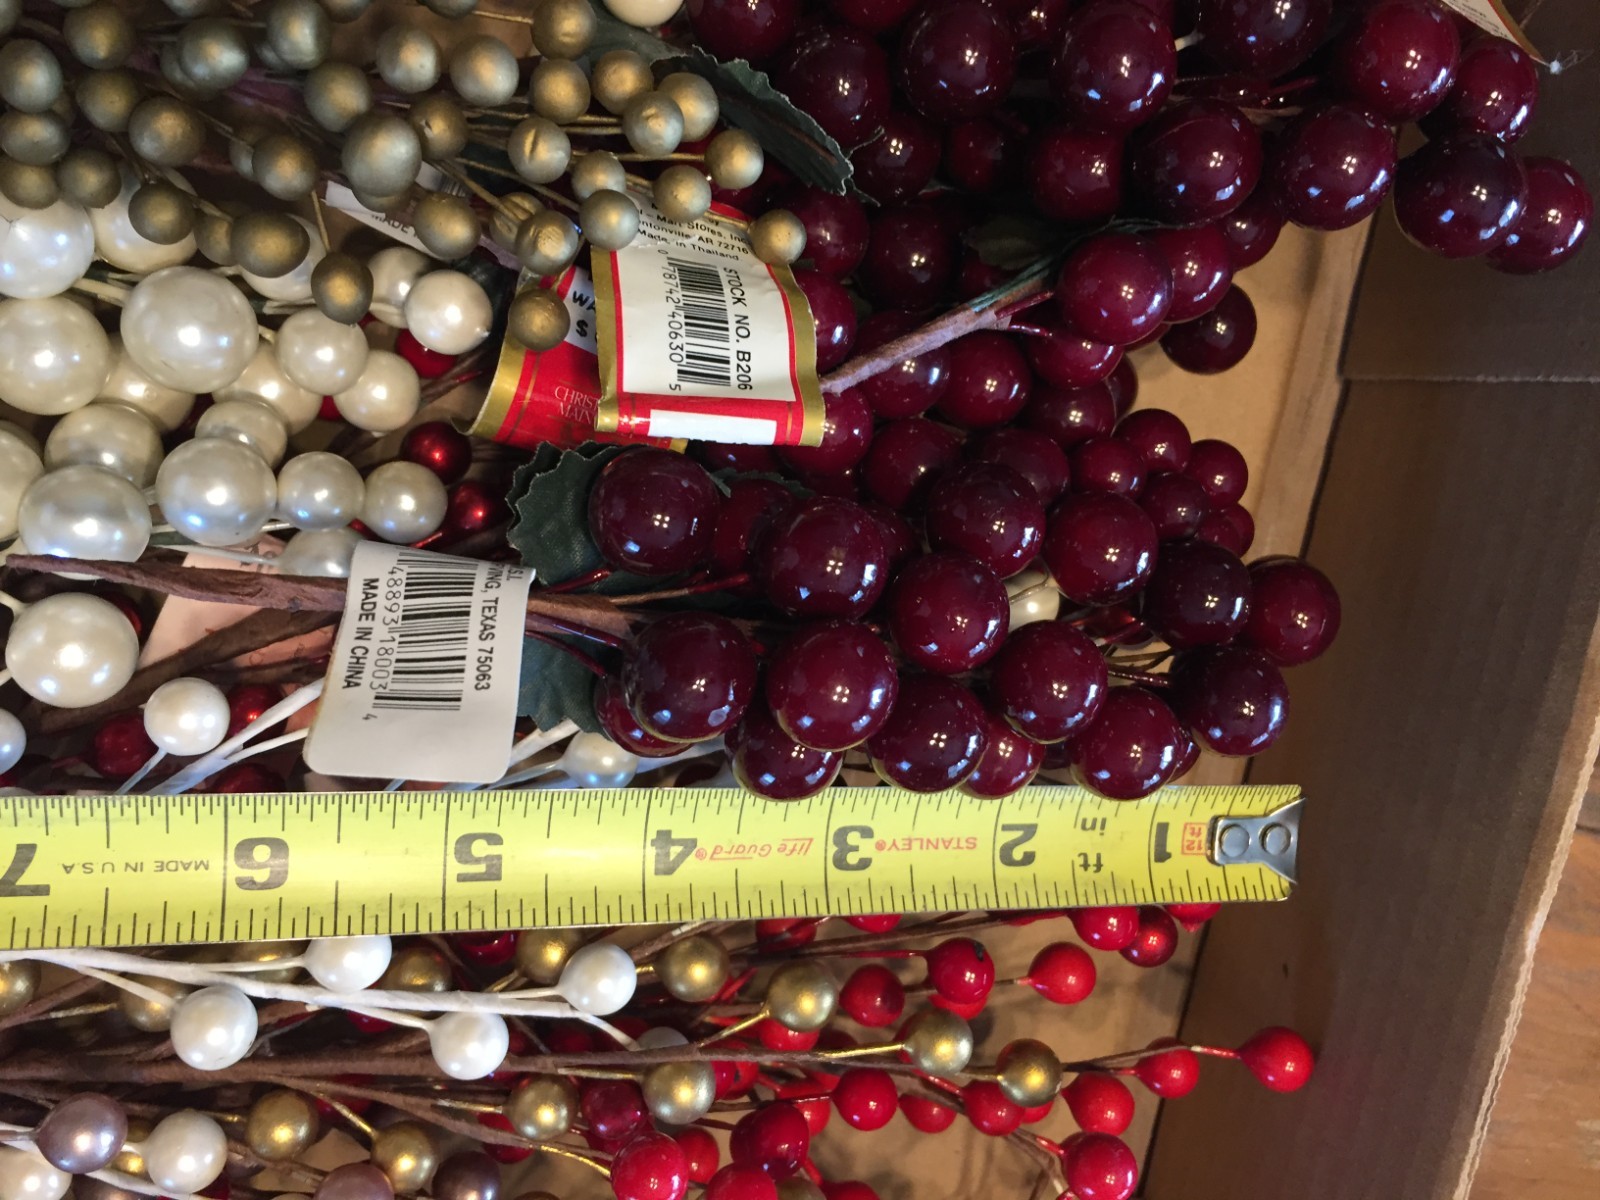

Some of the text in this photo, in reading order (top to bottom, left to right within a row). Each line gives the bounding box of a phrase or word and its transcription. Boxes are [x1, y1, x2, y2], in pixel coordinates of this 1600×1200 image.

[675, 241, 687, 249] in
[697, 236, 714, 246] AR
[717, 241, 750, 255] 72716
[661, 265, 682, 304] 78742
[667, 311, 684, 364] 40630
[724, 267, 753, 391] STOCK NO. B206
[554, 385, 600, 411] CHRIST
[669, 383, 682, 391] 5
[382, 566, 405, 626] 48893
[342, 578, 380, 689] MADE IN CHINA
[478, 597, 499, 642] TEXAS
[369, 636, 397, 690] 18003
[473, 646, 494, 691] 75063
[832, 825, 874, 871] 3
[999, 823, 1038, 867] 2
[1080, 817, 1107, 835] in
[1154, 822, 1172, 863] 1
[0, 843, 51, 897] 7
[124, 862, 144, 872] IN
[153, 860, 209, 871] MADE
[234, 837, 289, 891] 6
[454, 832, 503, 882] 5
[650, 830, 697, 876] 4
[1078, 852, 1104, 873] ft
